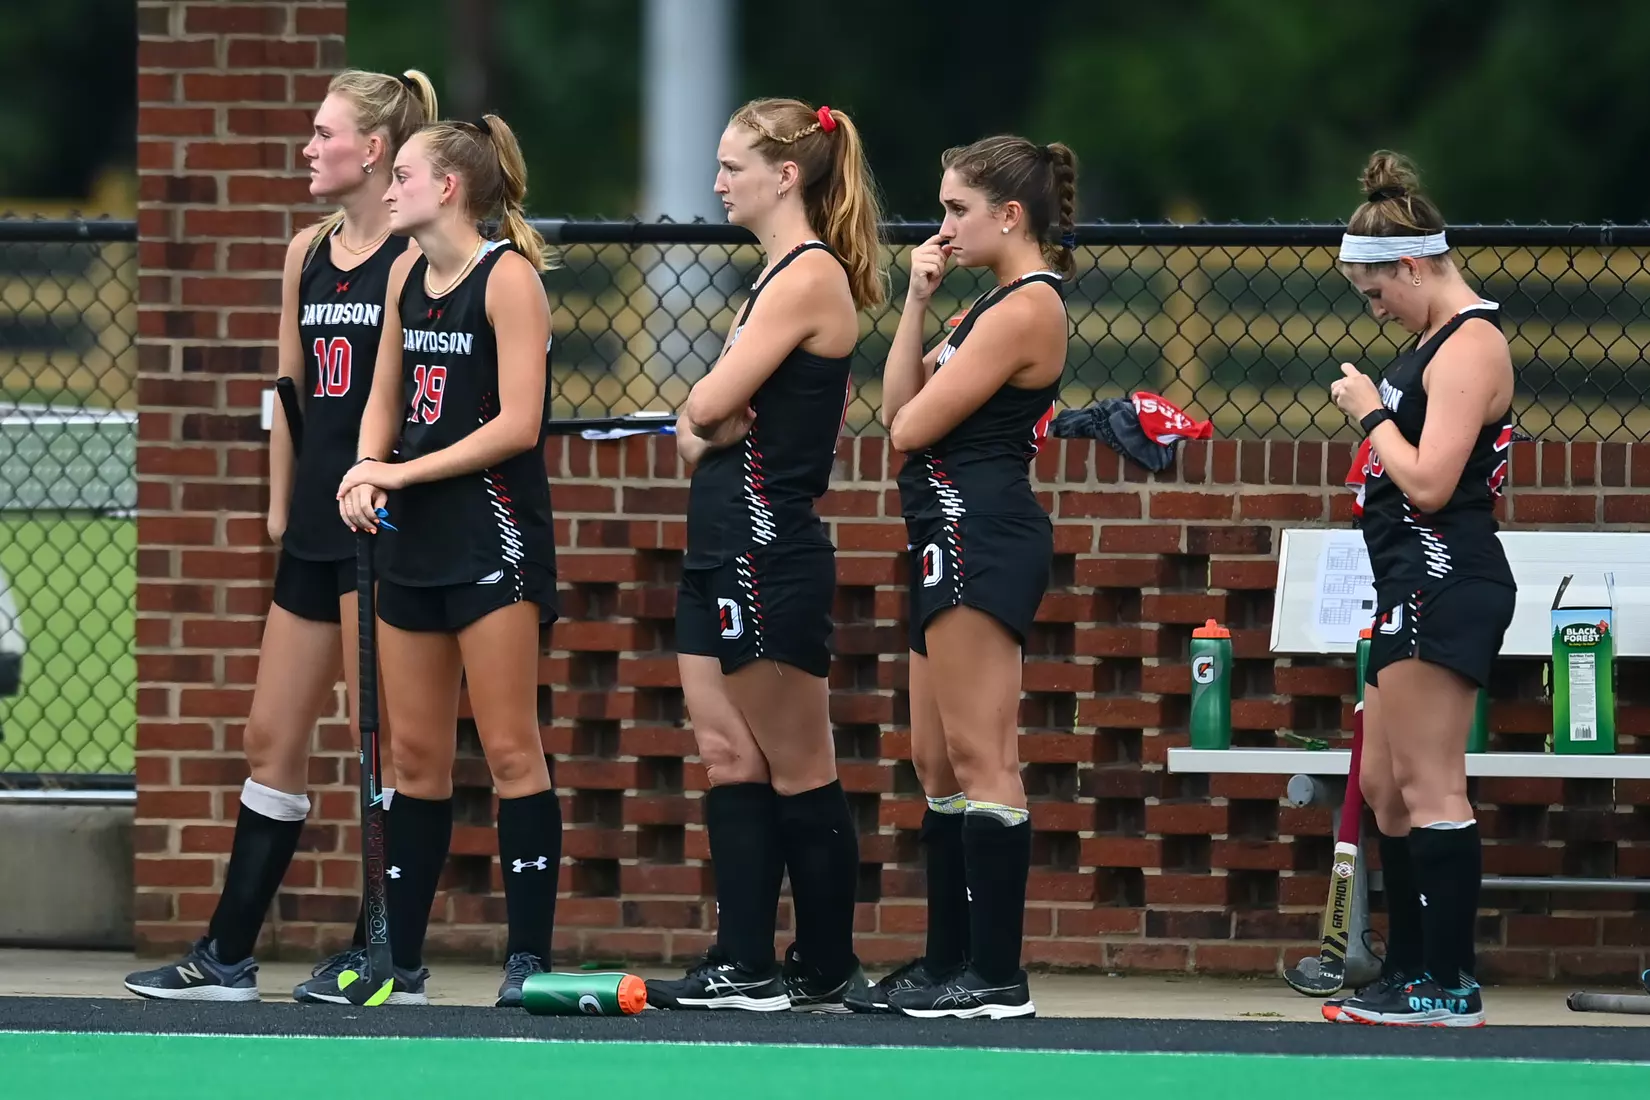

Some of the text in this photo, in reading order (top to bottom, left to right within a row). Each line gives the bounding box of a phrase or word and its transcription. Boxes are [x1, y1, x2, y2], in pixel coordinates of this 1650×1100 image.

[313, 337, 352, 397] 10
[410, 364, 447, 424] 19
[1566, 627, 1597, 635] BLACK
[1193, 656, 1215, 684] G
[1332, 878, 1348, 929] GRYPHON
[1408, 996, 1468, 1014] OSAKA
